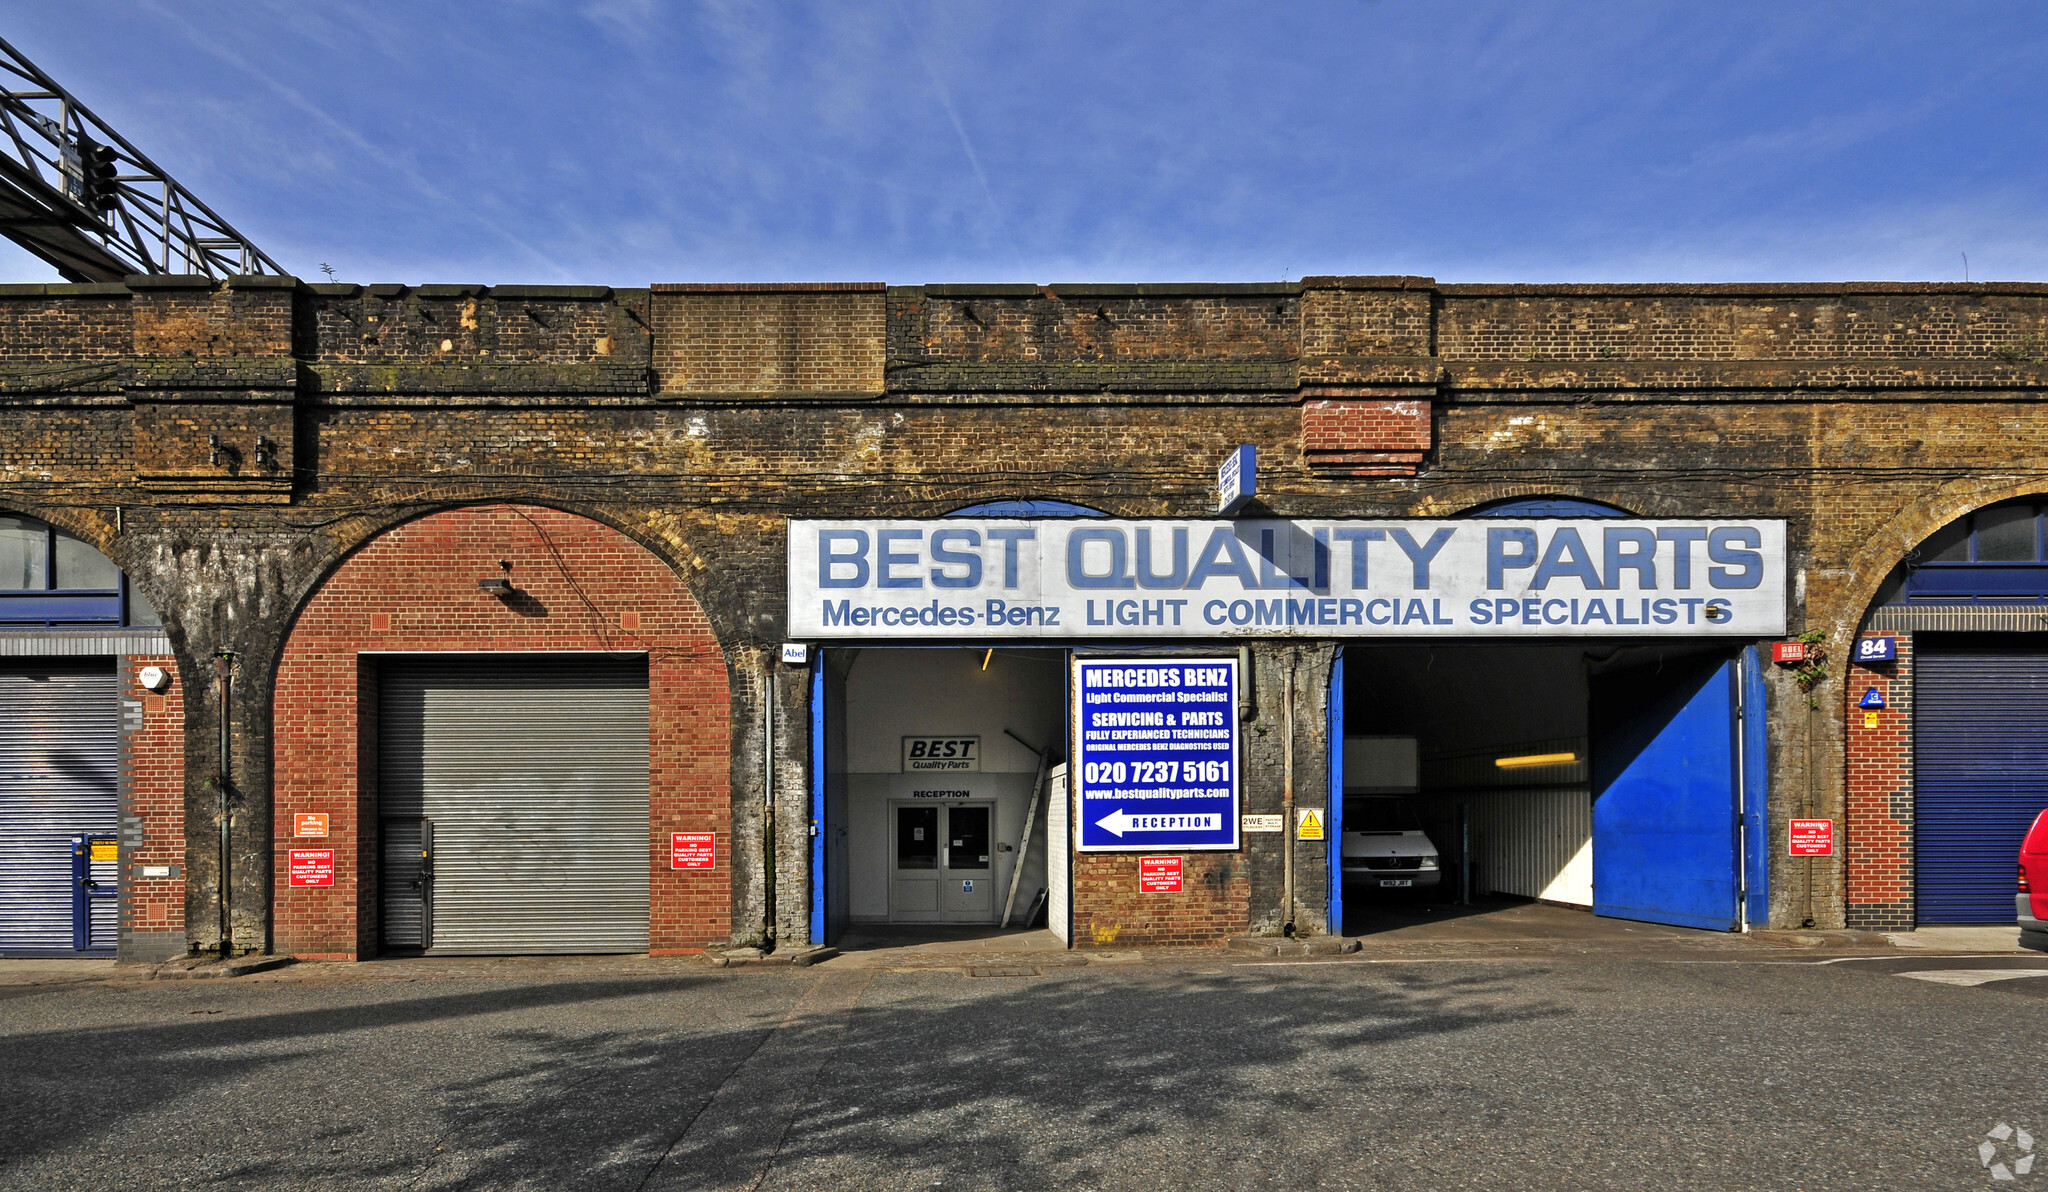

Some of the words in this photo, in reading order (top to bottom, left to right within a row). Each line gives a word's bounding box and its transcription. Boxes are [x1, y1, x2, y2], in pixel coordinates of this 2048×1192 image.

[818, 528, 1037, 589] BEST
[1066, 527, 1458, 590] QUALITY
[1487, 527, 1764, 590] PARTS
[822, 599, 1061, 627] Mercedes-Benz
[1087, 599, 1188, 626] LIGHT
[1203, 598, 1453, 626] COMMERCIAL
[1469, 598, 1733, 625] SPECIALISTS
[784, 648, 806, 658] Abel
[1861, 639, 1887, 655] 84
[1086, 668, 1181, 687] MERCEDES
[1184, 668, 1228, 687] BENZ
[1086, 692, 1112, 704] Light
[1113, 692, 1175, 703] Commercial
[1177, 692, 1228, 704] Specialist
[1092, 712, 1164, 727] SERVICING
[1166, 713, 1177, 726] &
[1182, 712, 1223, 726] PARTS
[1086, 730, 1110, 740] FULLY
[1112, 730, 1170, 740] EXPERIANCED
[1172, 729, 1230, 740] TECHNICIANS
[910, 740, 975, 757] BEST
[1086, 744, 1116, 752] ORIGINAL
[1118, 743, 1151, 751] MERCEDES
[1169, 742, 1212, 750] DIAGNOSTICS
[1213, 742, 1230, 750] USED
[913, 761, 946, 770] Quality
[1085, 762, 1126, 784] 020
[1130, 761, 1179, 783] 7237
[1183, 760, 1230, 782] 5161
[913, 790, 970, 798] RECEPTION
[1085, 787, 1230, 800] www.bestqualityparts.com
[1132, 816, 1211, 828] RECEPTION
